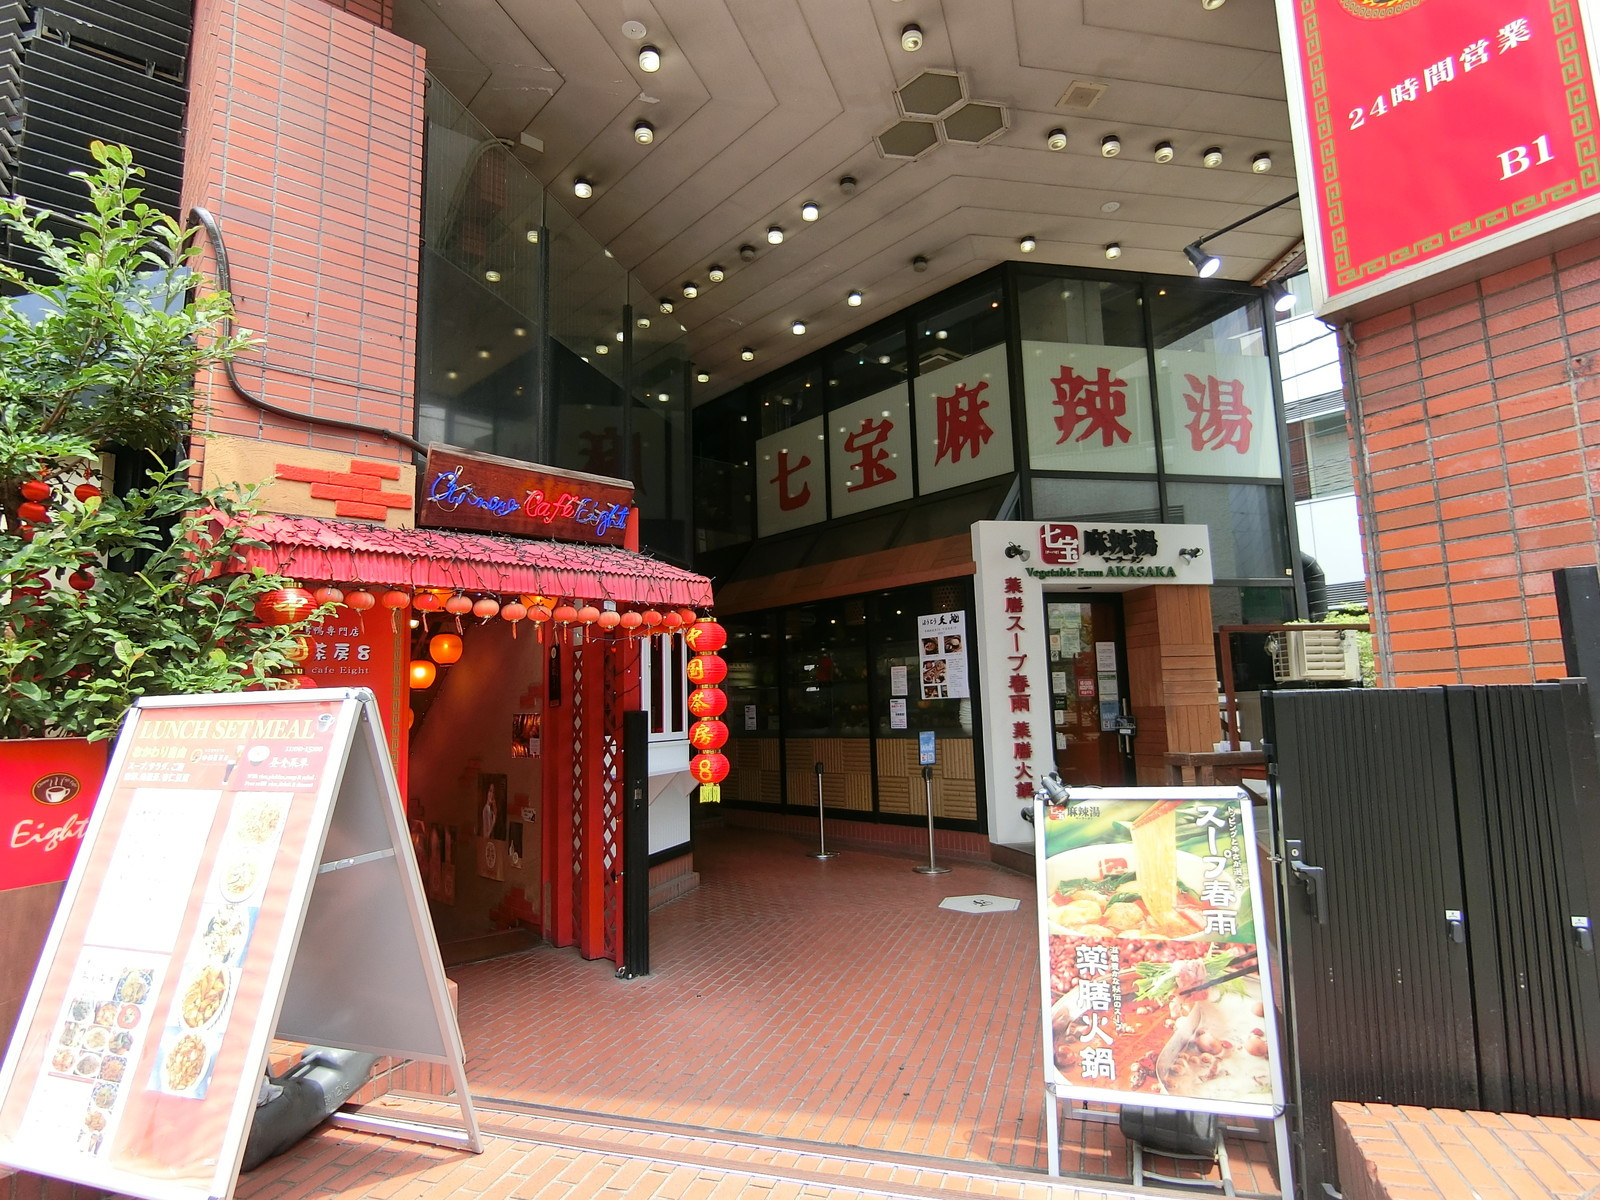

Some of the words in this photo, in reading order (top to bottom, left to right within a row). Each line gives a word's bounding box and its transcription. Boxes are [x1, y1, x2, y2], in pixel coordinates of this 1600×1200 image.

[1348, 18, 1531, 130] 24時間営業
[1496, 134, 1555, 181] B1
[769, 365, 1253, 512] 七宝麻辣湯
[1041, 524, 1079, 563] 七宝
[1083, 529, 1158, 556] 麻辣湯
[1025, 567, 1077, 579] Vegetable
[1078, 568, 1103, 578] Farm
[1105, 565, 1177, 578] AKASAKA
[339, 666, 369, 675] Eight
[138, 719, 209, 739] LUNCH
[10, 813, 90, 852] Eight
[1195, 805, 1238, 936] スープ春雨
[1075, 943, 1117, 1081] 薬膳火鍋
